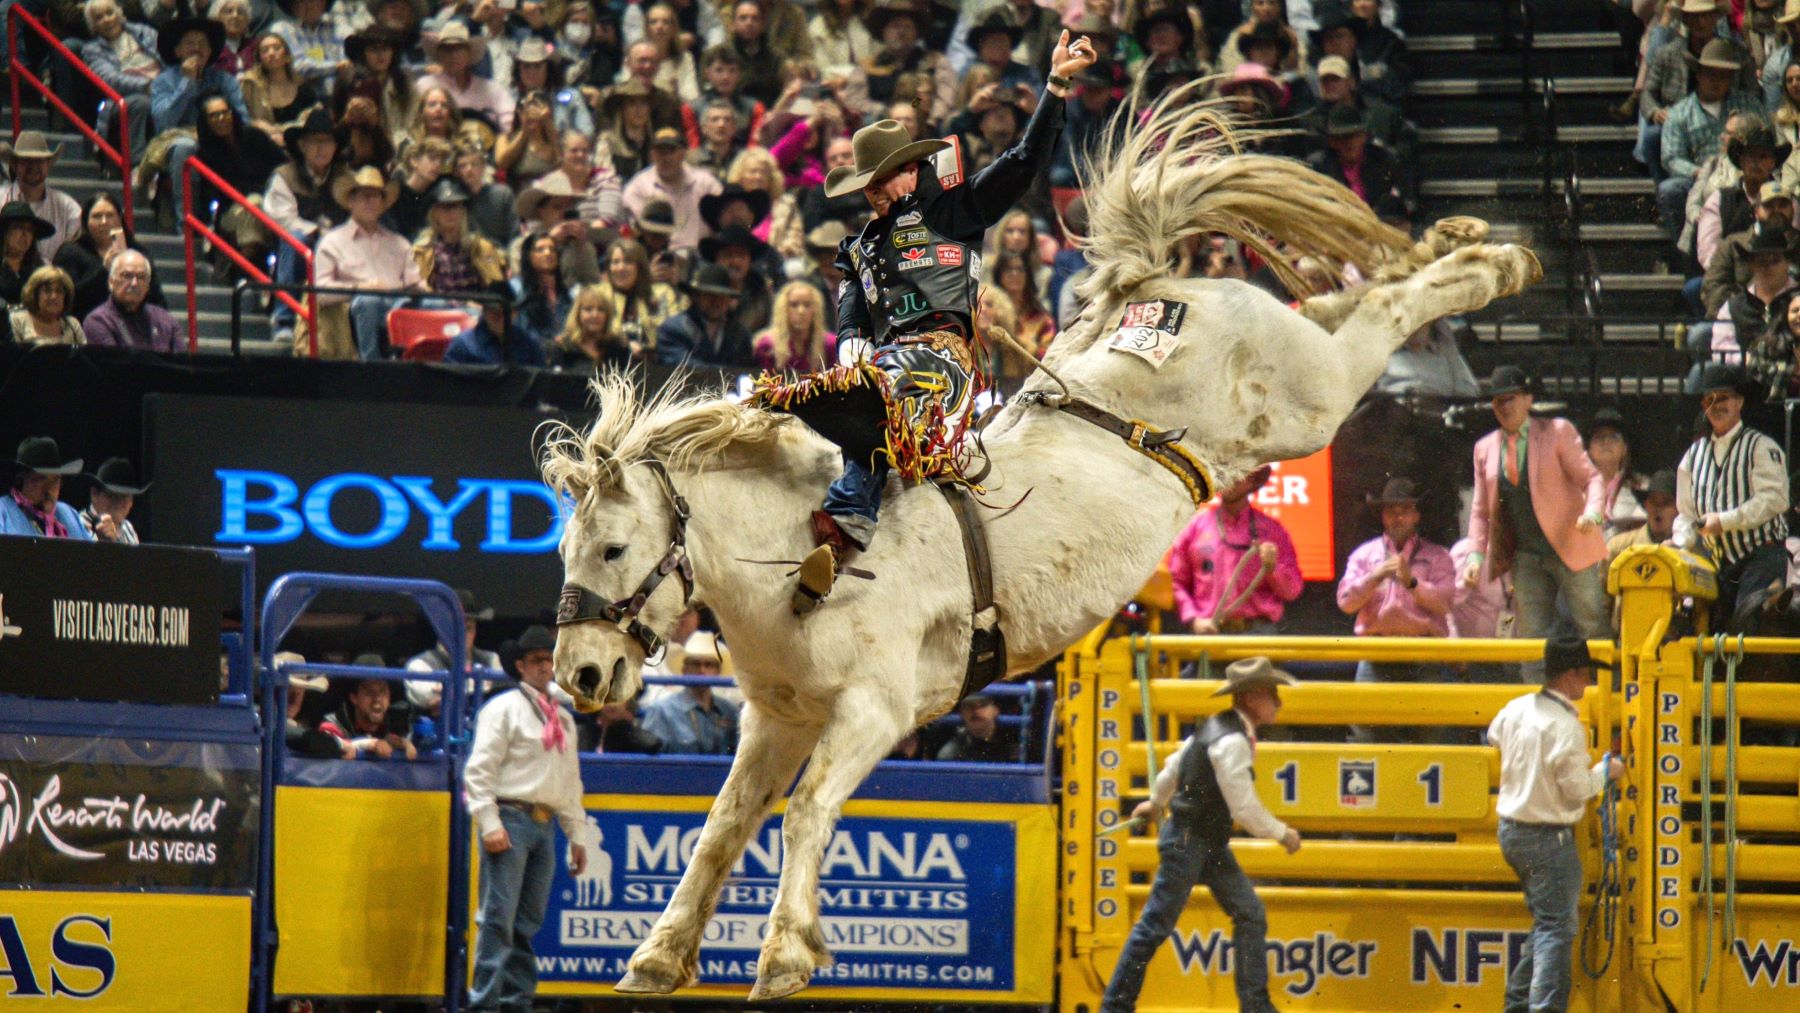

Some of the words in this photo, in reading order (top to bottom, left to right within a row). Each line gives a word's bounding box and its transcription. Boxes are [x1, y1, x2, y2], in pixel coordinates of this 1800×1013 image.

[215, 469, 574, 553] BOYD
[53, 599, 190, 647] VISITLASVEGAS.COM
[1096, 690, 1119, 918] PRORODEO
[1274, 761, 1299, 804] 1
[1418, 763, 1441, 807] 1
[132, 793, 222, 833] World
[1658, 693, 1681, 929] PRORODEO
[128, 840, 159, 861] LAS
[163, 841, 218, 865] VEGAS
[626, 824, 967, 878] MNANA
[624, 882, 968, 911] SIERMITHS
[703, 919, 747, 942] OF
[1170, 929, 1377, 995] Wrngler
